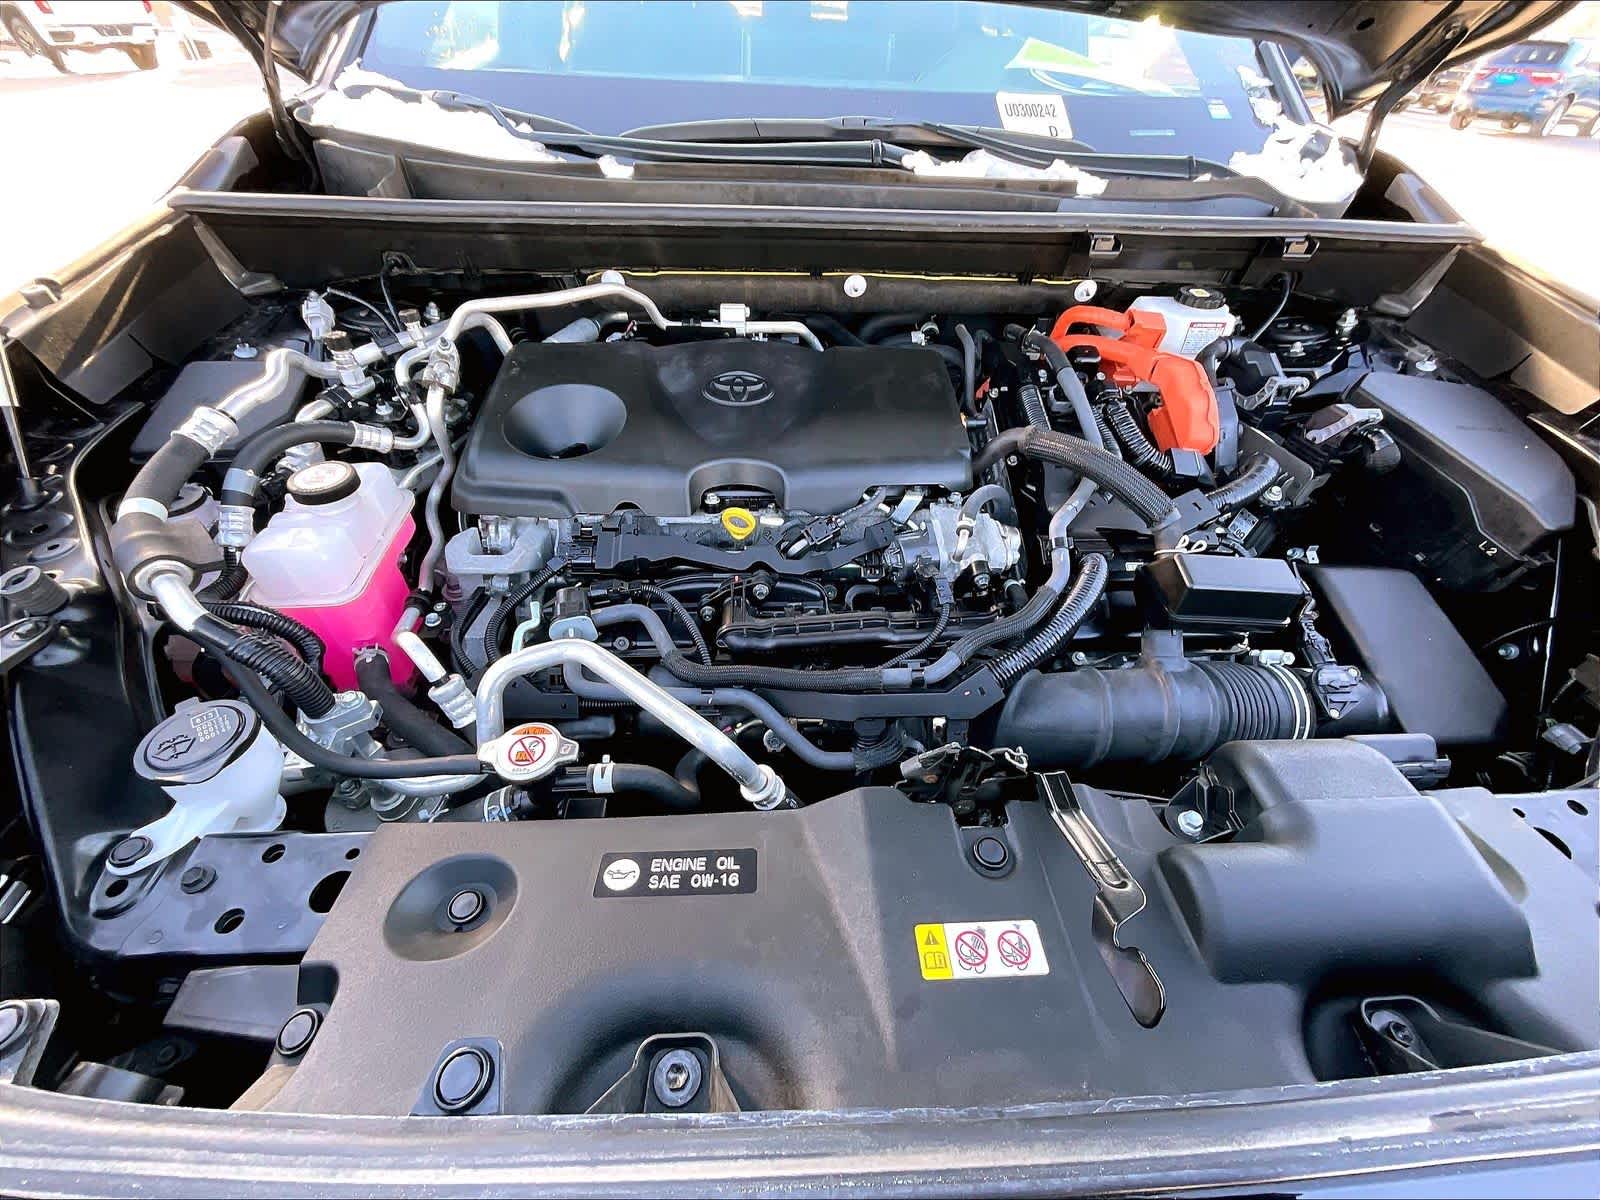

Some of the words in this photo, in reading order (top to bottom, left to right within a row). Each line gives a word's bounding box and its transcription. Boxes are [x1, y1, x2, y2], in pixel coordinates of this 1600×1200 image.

[1004, 103, 1057, 118] U0300242
[1478, 540, 1498, 557] L2
[650, 857, 708, 872] ENGINE
[716, 856, 741, 870] OIL
[648, 874, 681, 889] SAE
[690, 872, 740, 888] 0W-16
